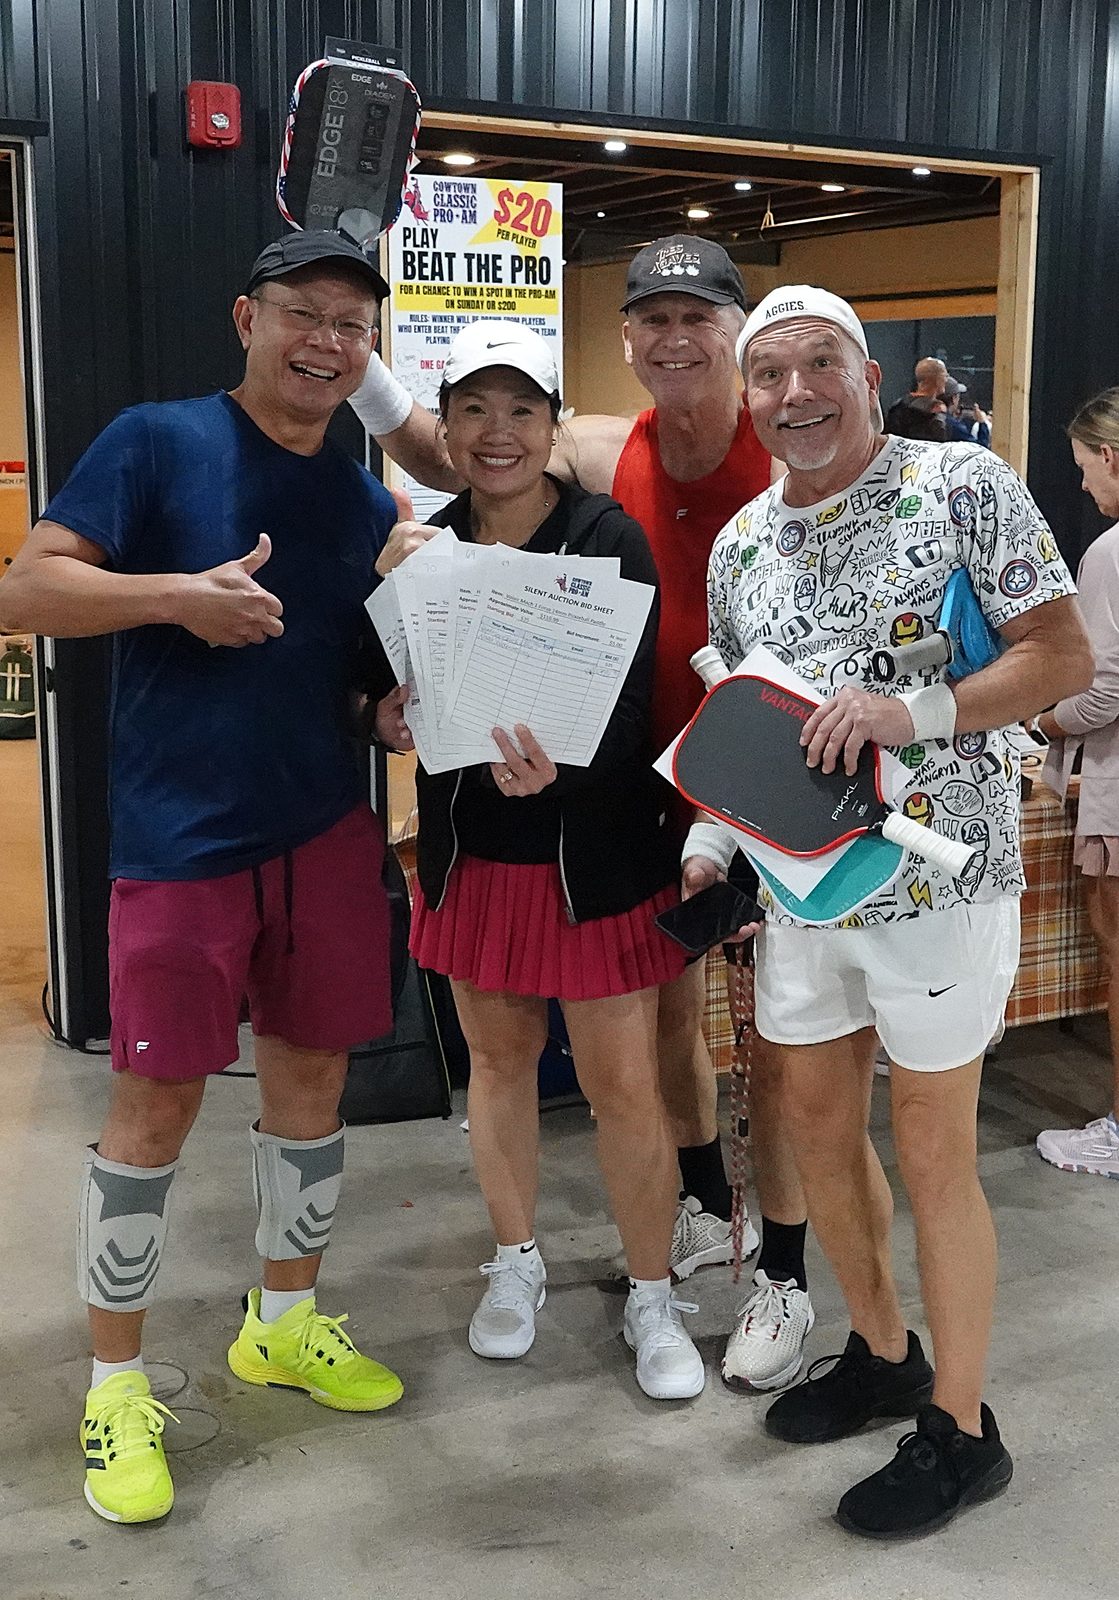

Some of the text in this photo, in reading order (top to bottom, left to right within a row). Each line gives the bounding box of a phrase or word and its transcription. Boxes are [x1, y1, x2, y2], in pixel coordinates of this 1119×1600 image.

[351, 73, 372, 84] EDGE
[433, 181, 477, 194] COWTOWN
[433, 194, 477, 209] CLASSIC
[494, 188, 553, 238] $20
[403, 227, 438, 249] PLAY
[497, 228, 537, 249] PER PLAYER
[403, 250, 551, 285] BEAT THE PRO
[400, 285, 556, 299] FOR A CHANCE TO WIN A SPOT IN THE PRO-AM
[445, 299, 517, 311] ON SUNDAY OR $200
[765, 300, 805, 319] AGGIES
[409, 314, 430, 323] RULES:
[431, 315, 455, 323] WINNER
[456, 315, 471, 324] WILL
[521, 317, 546, 326] PLAYERS
[398, 325, 412, 334] WHO
[413, 325, 432, 334] ENTER
[434, 326, 448, 334] BEAT
[541, 328, 557, 336] TEAM
[425, 336, 450, 345] PLAYING
[420, 360, 434, 369] ONE
[1022, 550, 1046, 572] SINCE
[524, 585, 615, 615] SILENT AUCTION BID SHEET
[894, 578, 931, 607] ALWAYS
[828, 596, 860, 618] HULK
[797, 628, 879, 660] AVENGERS
[831, 782, 859, 821] PIKKL
